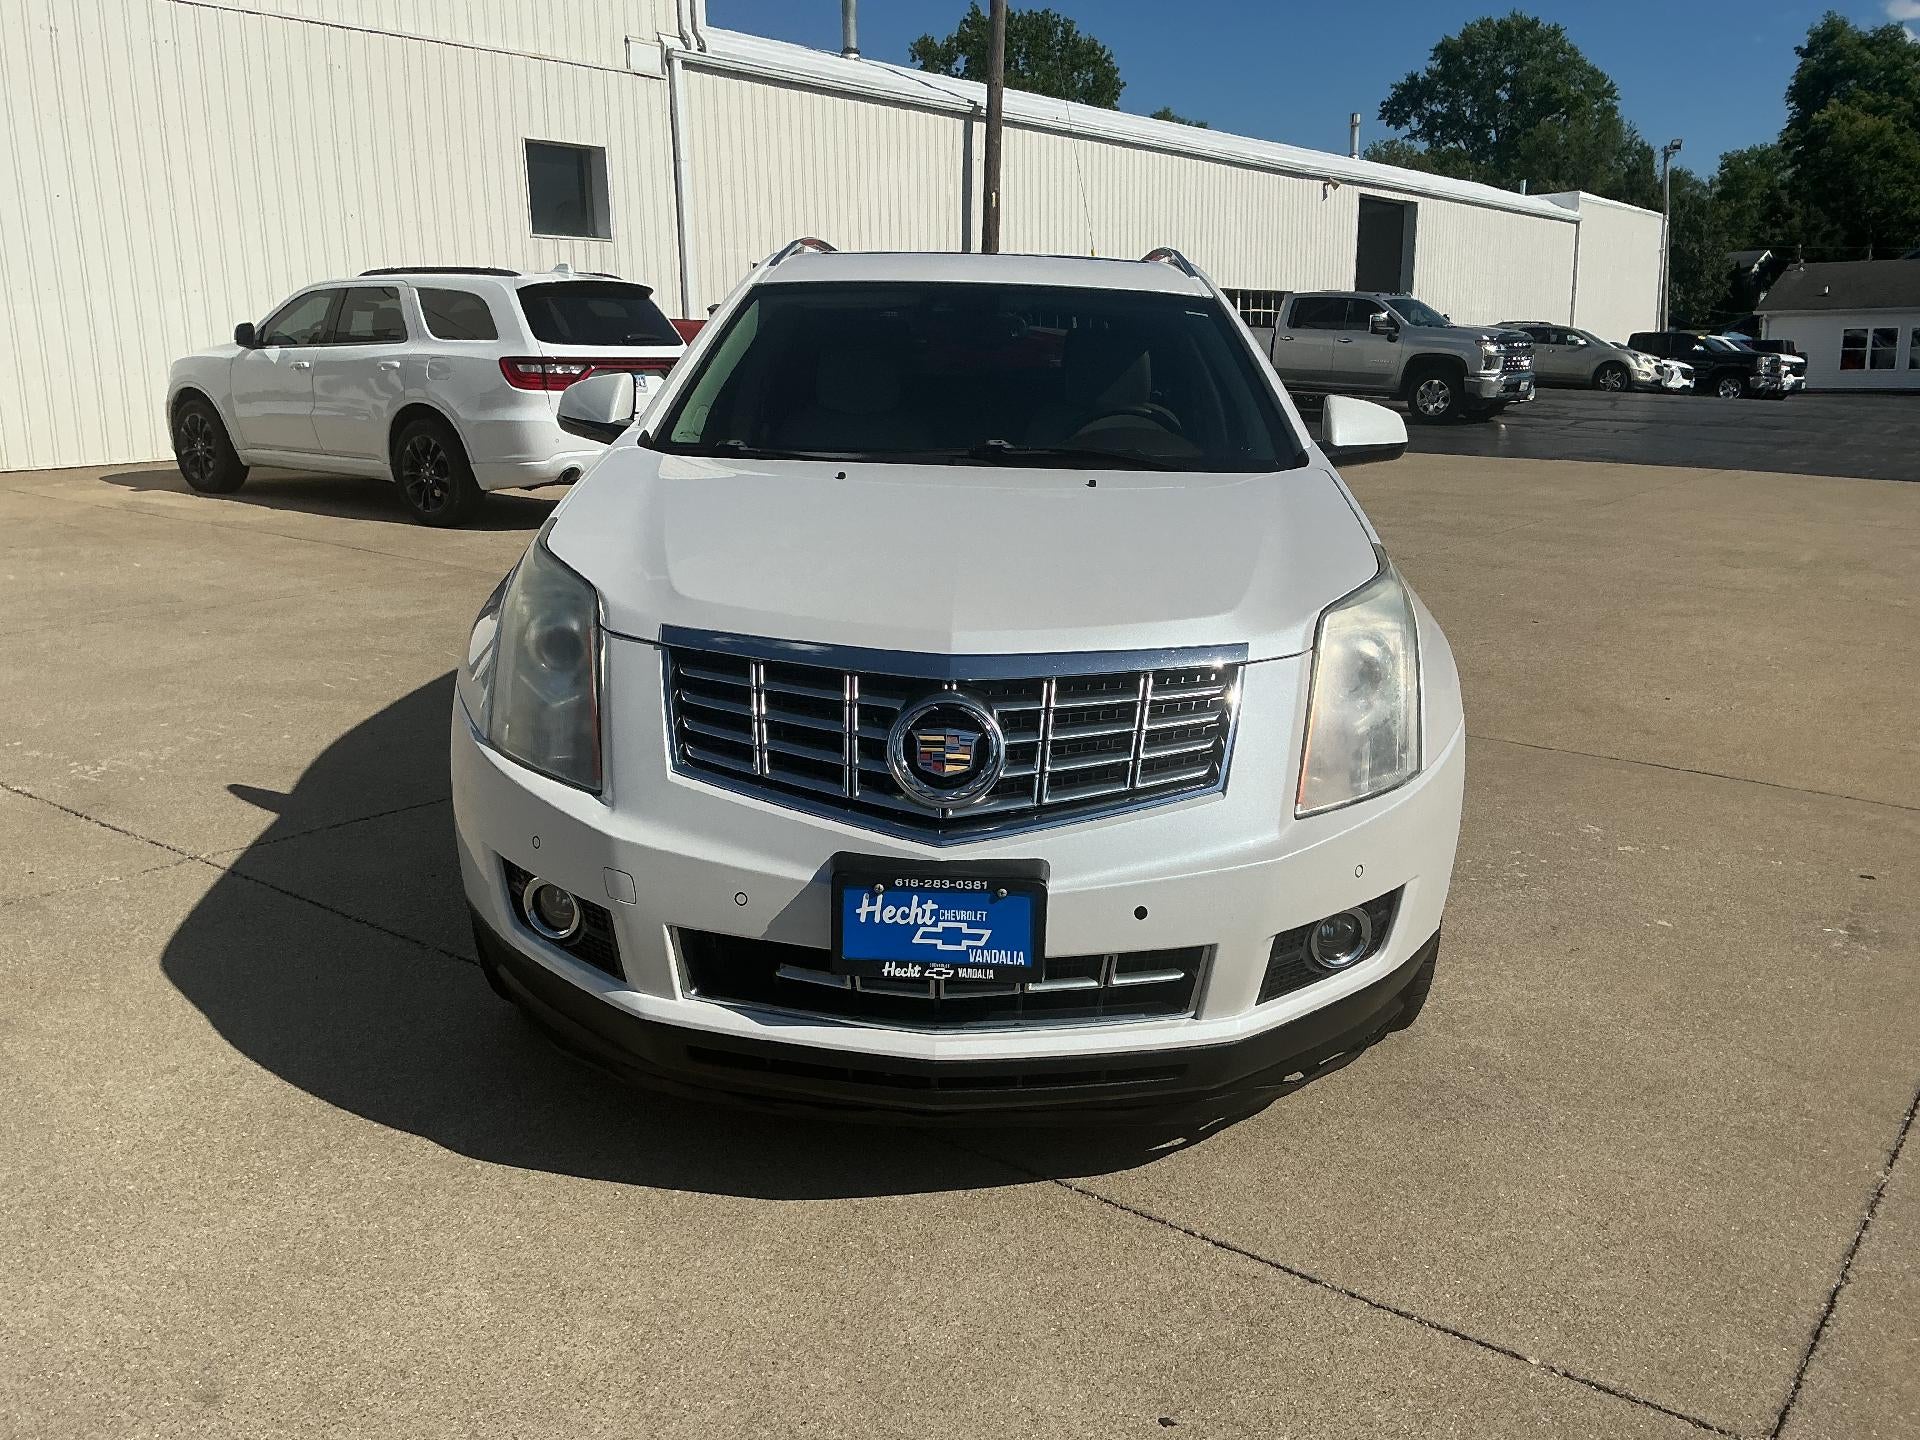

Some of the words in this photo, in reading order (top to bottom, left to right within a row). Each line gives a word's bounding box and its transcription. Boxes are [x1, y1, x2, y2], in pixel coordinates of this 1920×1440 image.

[894, 878, 988, 890] 618-283-0381
[855, 892, 939, 926] Hecht
[939, 909, 988, 922] CHEVROLET
[968, 948, 1025, 966] VANDALIA
[881, 961, 922, 977] Hecht
[957, 967, 995, 980] VANDALIA
